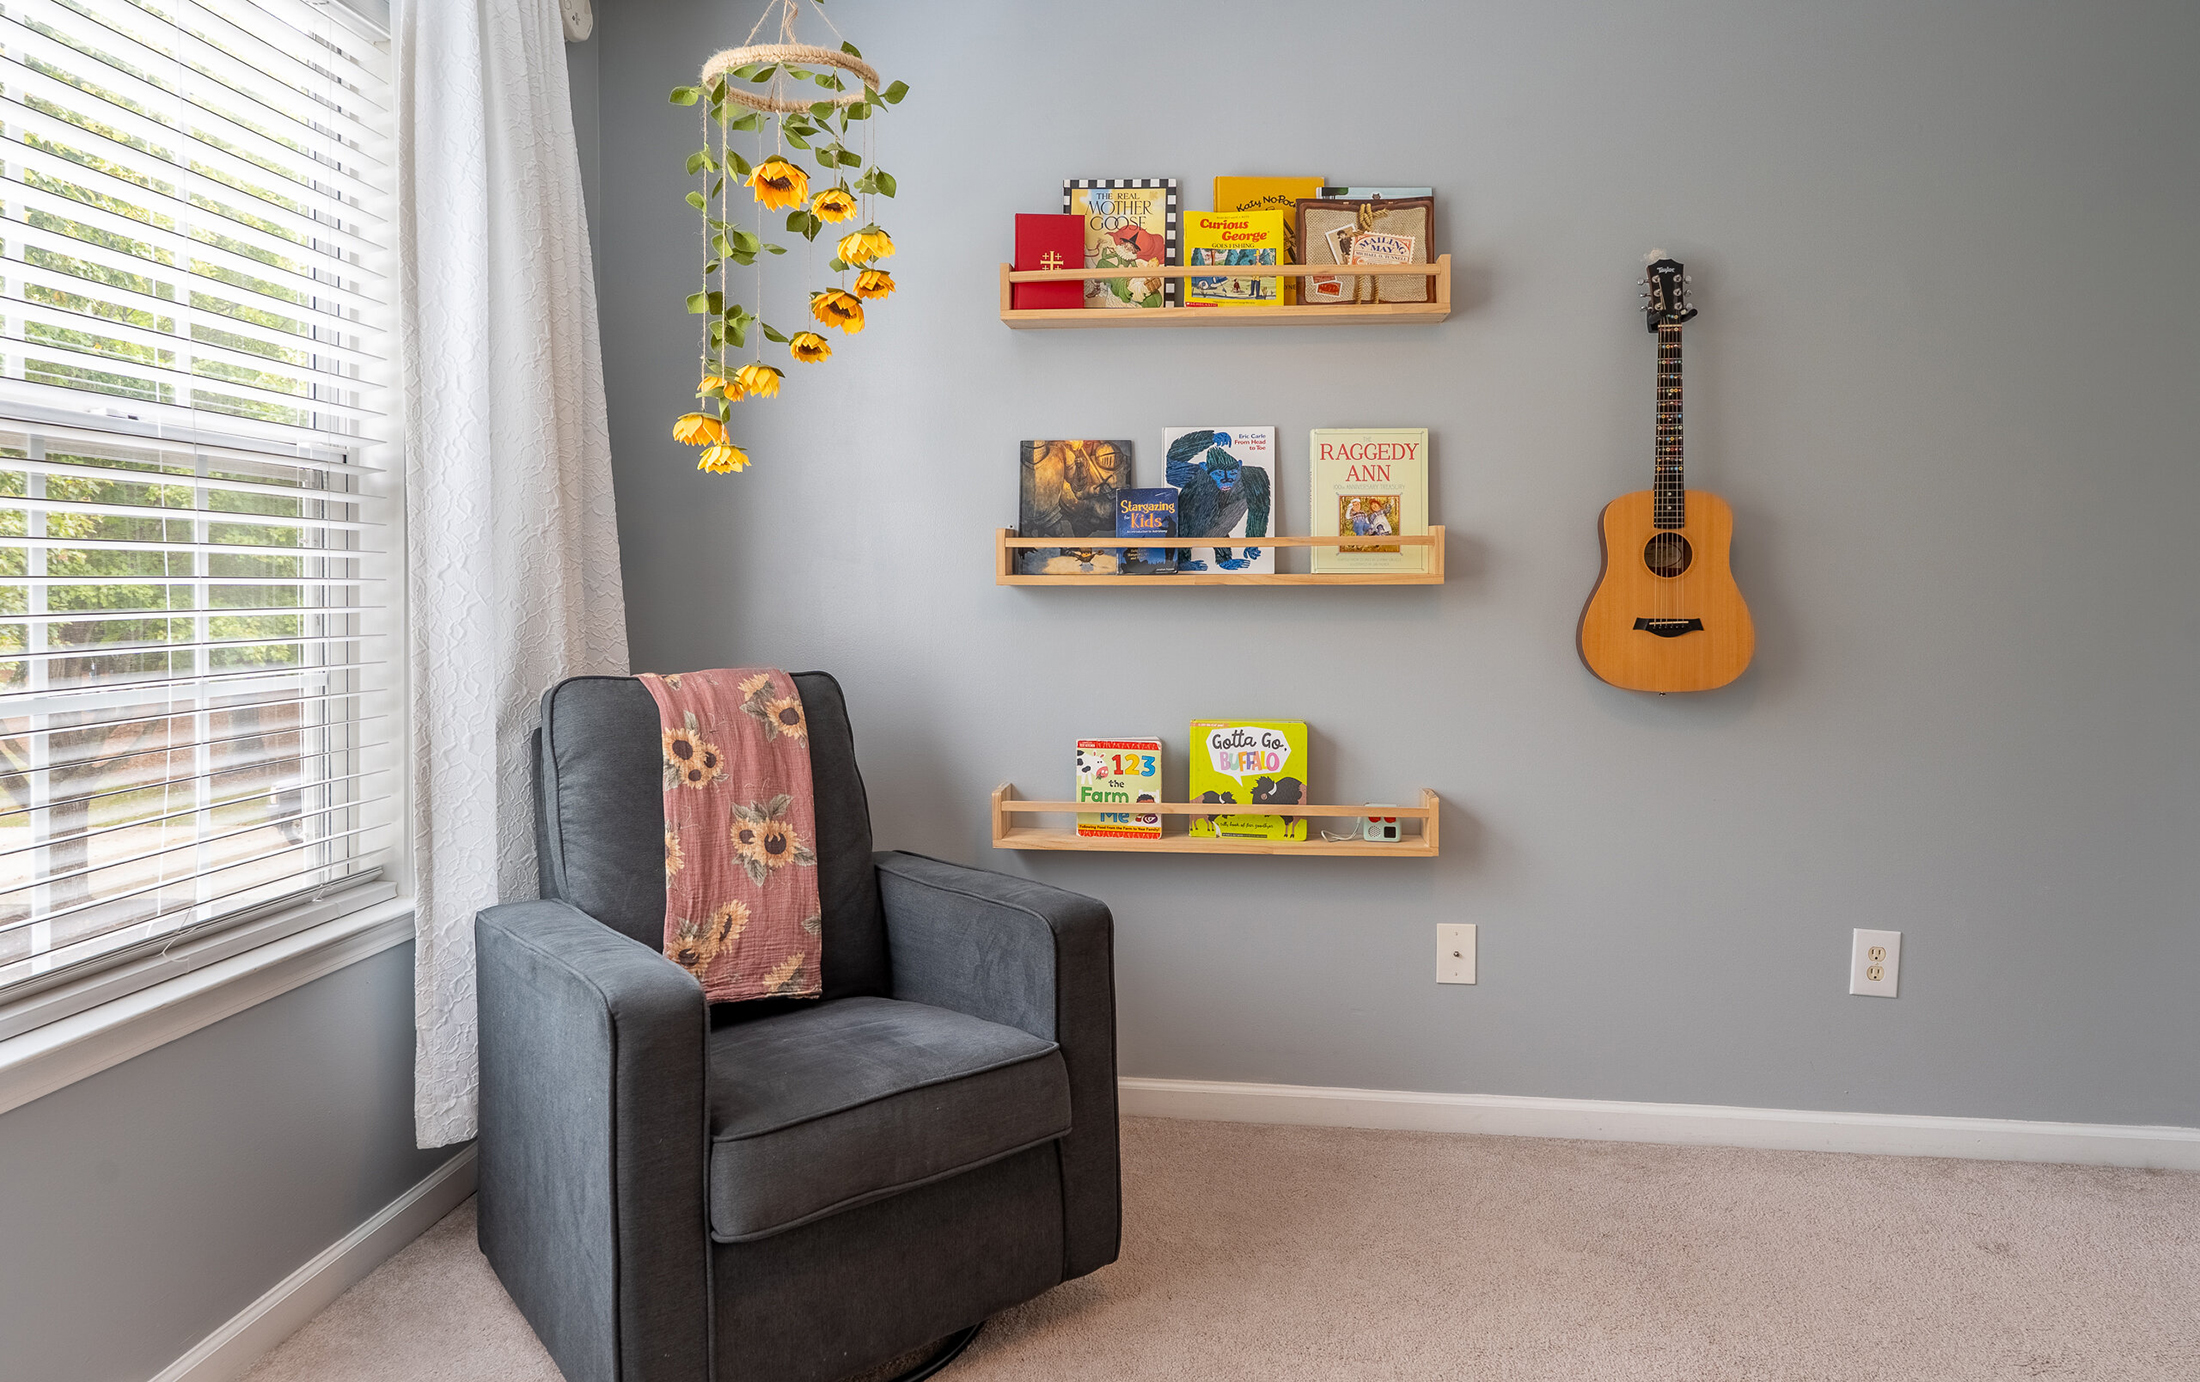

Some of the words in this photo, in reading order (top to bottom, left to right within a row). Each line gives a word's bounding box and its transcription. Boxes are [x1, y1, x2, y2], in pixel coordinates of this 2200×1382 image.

[1096, 192, 1113, 200] THE
[1117, 192, 1140, 200] REAL
[1085, 200, 1153, 216] MOTHER
[1236, 200, 1262, 212] Katy
[1089, 215, 1148, 231] GOOSE
[1200, 218, 1249, 230] Curious
[1222, 230, 1267, 243] George
[1359, 237, 1407, 255] MAILING
[1370, 244, 1395, 254] MAY
[1656, 266, 1675, 274] Taylor
[1319, 442, 1420, 461] RAGGEDY
[1345, 464, 1391, 482] ANN
[1120, 499, 1176, 514] Stargazing
[1130, 513, 1163, 528] Kids
[1212, 729, 1257, 750] Gotta
[1219, 750, 1280, 772] BUFFALO
[1108, 779, 1125, 788] the
[1080, 786, 1130, 803] Farm
[1100, 812, 1130, 824] Me
